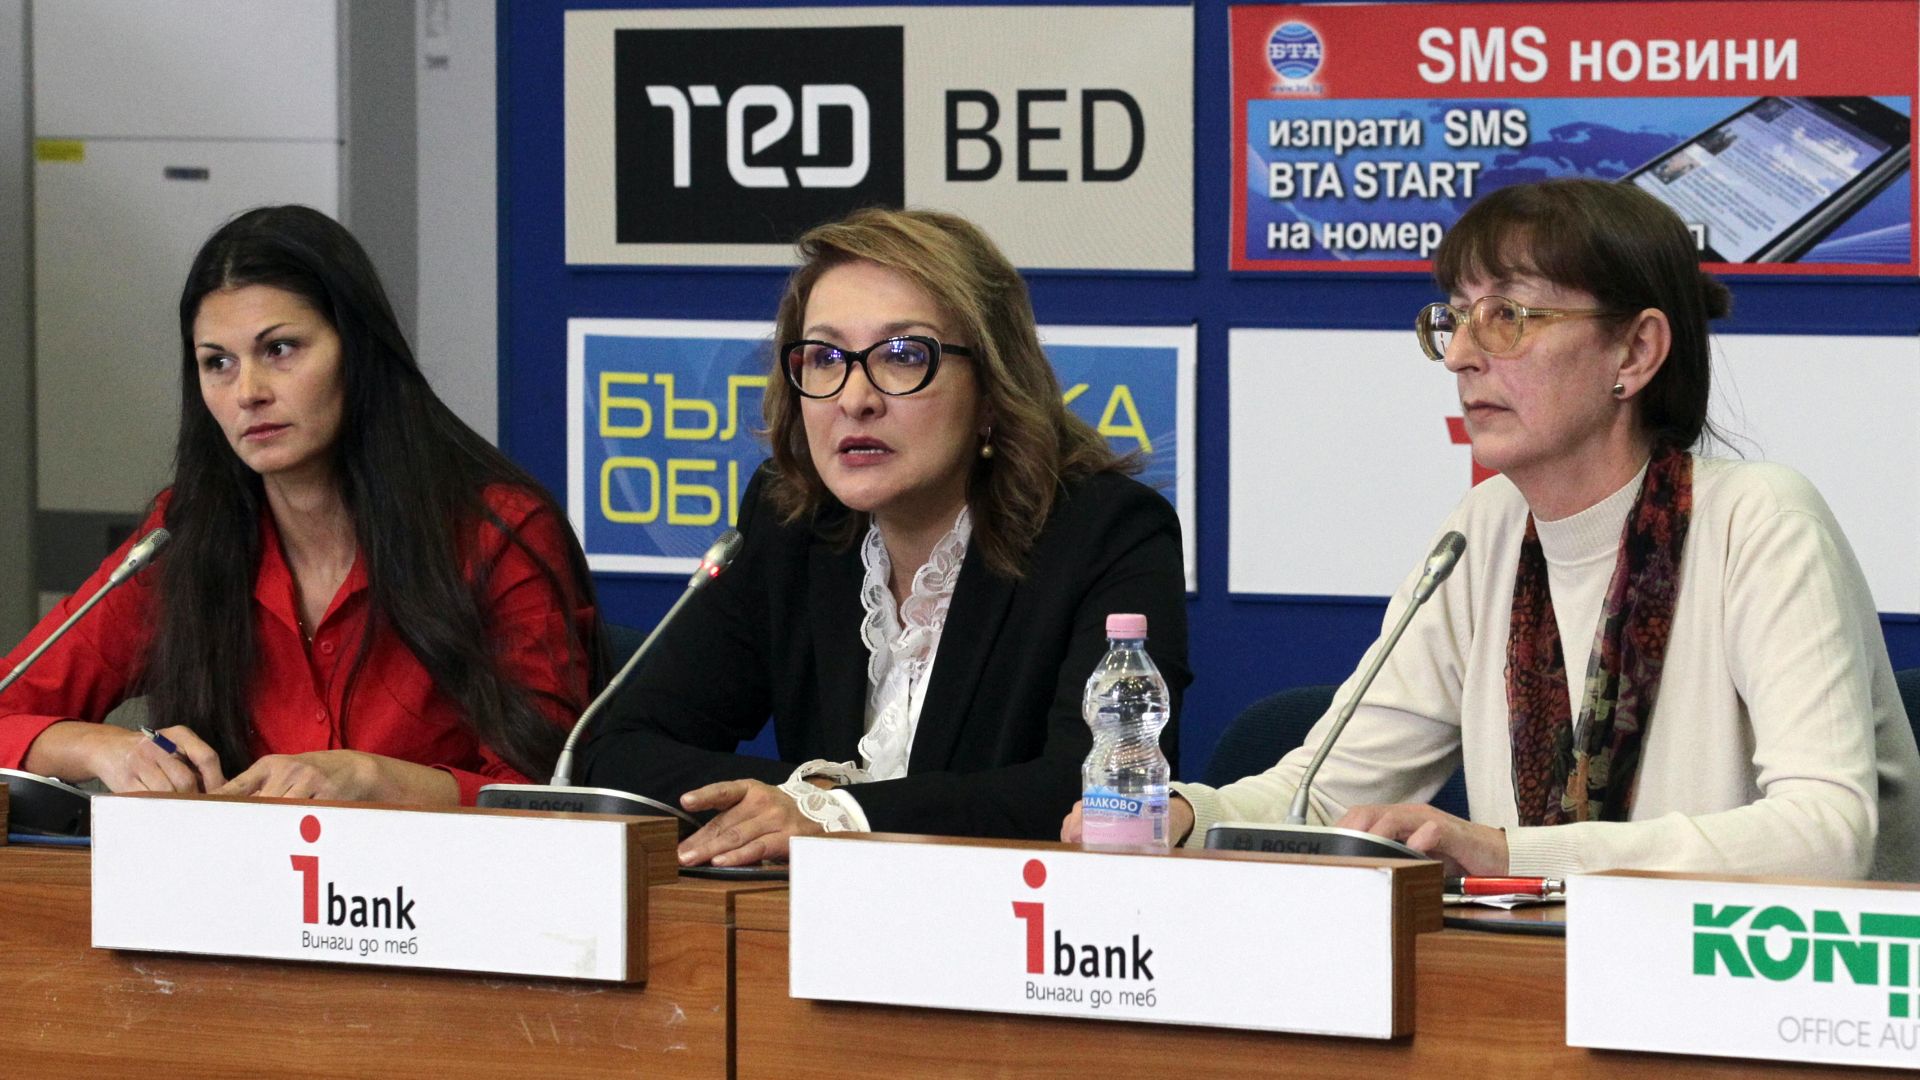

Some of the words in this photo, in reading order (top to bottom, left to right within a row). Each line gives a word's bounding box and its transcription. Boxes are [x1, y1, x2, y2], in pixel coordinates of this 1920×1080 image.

[1269, 43, 1321, 59] БТА
[1417, 26, 1548, 84] SMS
[945, 88, 1146, 183] BED
[1268, 119, 1421, 155] изпрати
[1444, 109, 1527, 147] SMS
[1268, 162, 1345, 198] BTA
[1353, 162, 1480, 199] START
[1267, 222, 1311, 249] на
[1323, 222, 1443, 258] номер
[302, 930, 354, 951] Винаги
[359, 938, 379, 957] до
[385, 937, 418, 955] теб
[1693, 903, 1920, 1019] KONT
[1025, 981, 1083, 1003] Винаги
[1090, 989, 1112, 1008] до
[1119, 988, 1157, 1007] теб
[1778, 1016, 1871, 1047] OFFICE
[1879, 1023, 1920, 1051] AU
